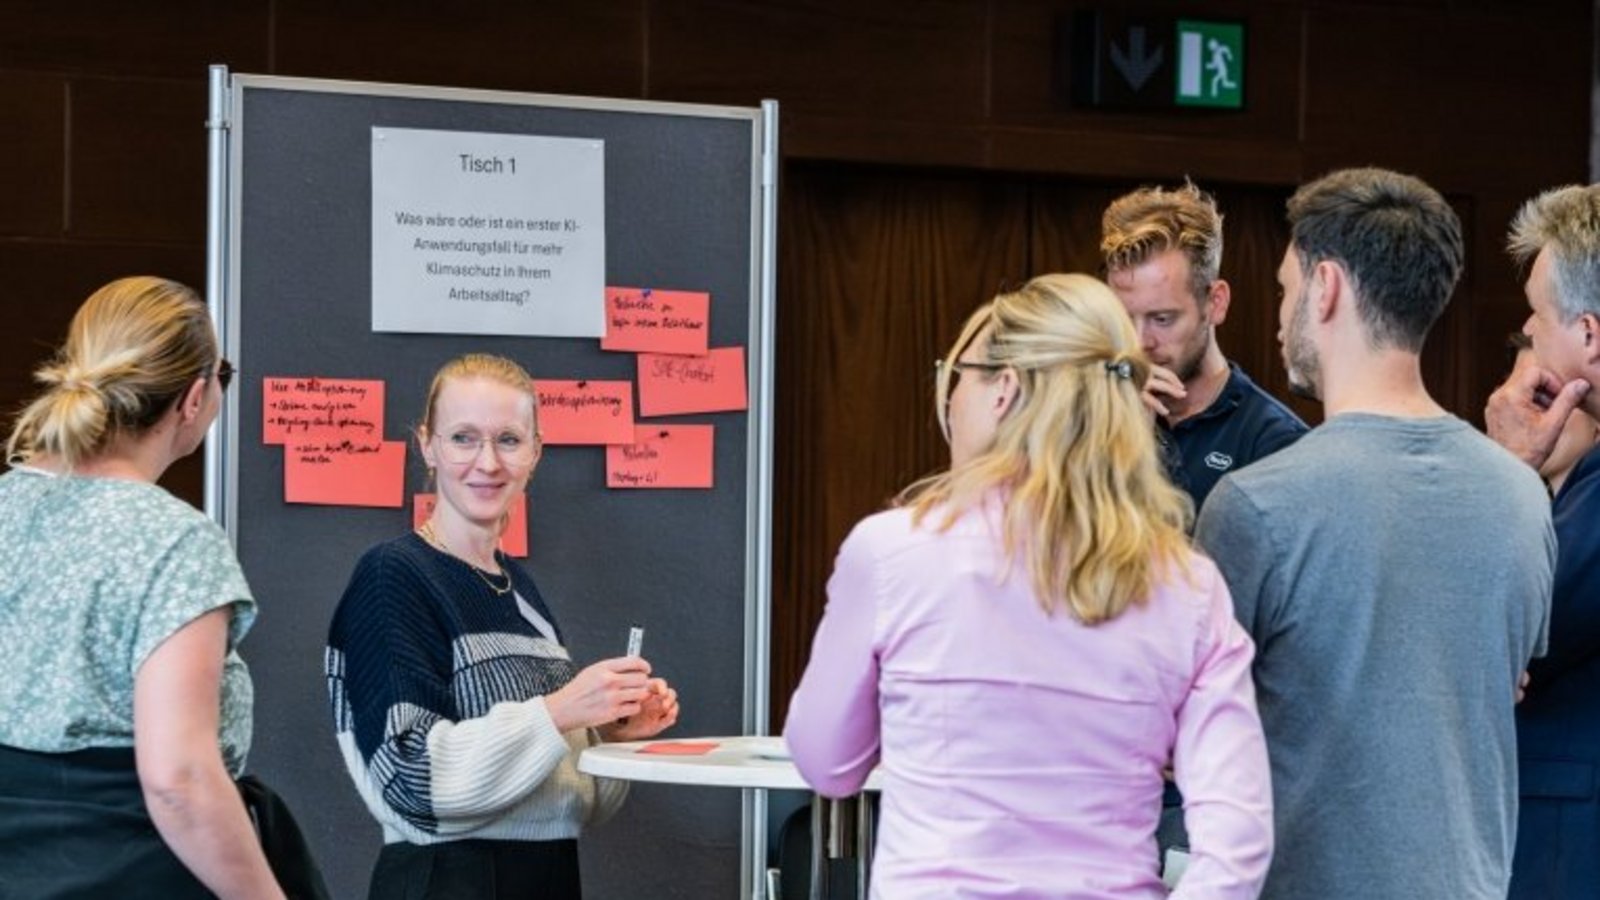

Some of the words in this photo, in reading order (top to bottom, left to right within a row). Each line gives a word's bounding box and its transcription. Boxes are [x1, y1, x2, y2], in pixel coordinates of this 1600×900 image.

[459, 154, 503, 173] Tisch
[508, 157, 515, 174] 1
[395, 212, 423, 226] Was
[426, 213, 454, 227] wäre
[458, 213, 486, 228] oder
[489, 214, 503, 229] ist
[506, 217, 524, 230] ein
[527, 218, 560, 231] erster
[564, 219, 580, 231] KI-
[414, 237, 511, 256] Anwendungsfall
[514, 240, 529, 254] für
[532, 243, 563, 255] mehr
[427, 262, 501, 277] Klimaschutz
[504, 264, 515, 278] in
[518, 265, 551, 279] Ihrem
[448, 287, 530, 306] Arbeitsalltag?
